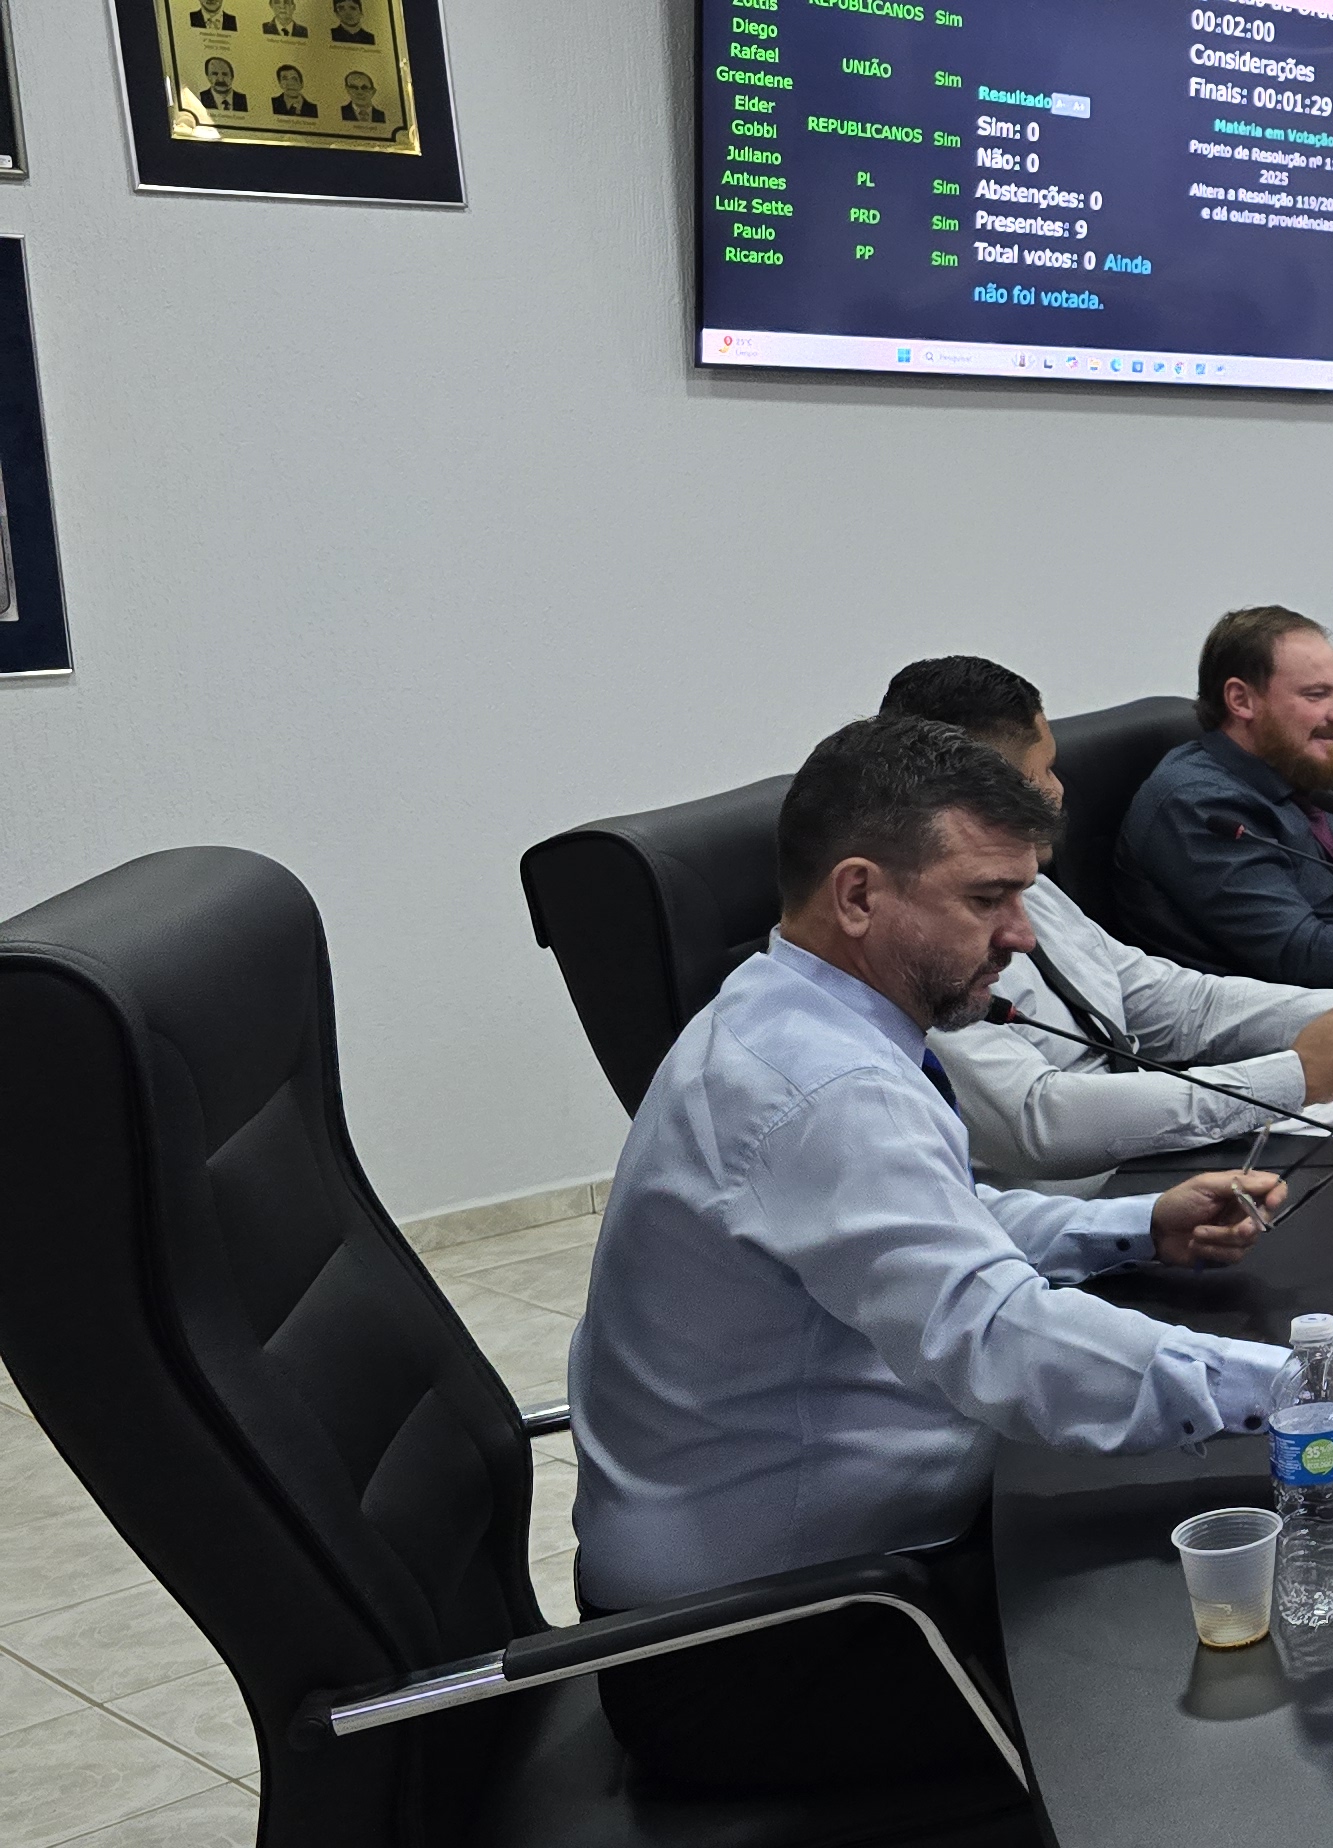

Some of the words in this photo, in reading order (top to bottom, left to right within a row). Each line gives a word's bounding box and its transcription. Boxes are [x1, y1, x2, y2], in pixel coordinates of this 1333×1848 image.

[809, 0, 924, 21] UBLICANOS
[935, 10, 963, 27] Sim
[732, 17, 778, 40] Diego
[1191, 8, 1275, 42] 00:02:00
[730, 42, 779, 63] Rafael
[1190, 43, 1315, 82] Considerações
[716, 66, 794, 90] Grendene
[842, 58, 892, 78] UNIÃO
[934, 71, 962, 88] Sim
[734, 94, 776, 114] Elder
[978, 86, 1052, 109] Resultado
[1189, 76, 1248, 105] Finais:
[1253, 86, 1333, 117] 00:01:29
[731, 119, 777, 139] Gobbi
[808, 116, 923, 143] REPUBLICANOS
[977, 115, 1021, 140] Sim:
[1026, 121, 1040, 142] 0
[1214, 118, 1262, 138] Matéria
[1265, 126, 1285, 141] em
[933, 131, 961, 148] Sim
[726, 145, 782, 165] Juliano
[977, 147, 1021, 171] Não:
[1026, 153, 1040, 173] 0
[1189, 139, 1232, 158] Projeto
[1234, 145, 1250, 160] de
[1251, 148, 1307, 168] Resolução
[721, 170, 787, 190] Antunes
[857, 171, 875, 188] PL
[932, 179, 960, 196] Sim
[1259, 169, 1289, 186] 2025
[975, 179, 1085, 209] Abstenções:
[1089, 191, 1103, 211] 0
[1189, 183, 1225, 199] Altera
[1227, 188, 1236, 201] a
[1238, 188, 1293, 208] Resolução
[715, 195, 748, 213] Luiz
[751, 198, 794, 217] Sette
[849, 207, 881, 225] PRD
[1201, 208, 1210, 219] e
[1212, 206, 1227, 221] dá
[1230, 209, 1266, 225] outras
[733, 222, 776, 241] Paulo
[931, 215, 959, 232] Sim
[975, 209, 1070, 238] Presentes:
[1075, 219, 1088, 239] 9
[725, 246, 784, 265] Ricardo
[855, 245, 874, 260] PP
[931, 251, 959, 267] Sim
[973, 241, 1019, 264] Total
[1024, 248, 1078, 269] votos:
[1083, 250, 1097, 271] 0
[1103, 253, 1152, 275] Ainda
[973, 282, 1007, 304] não
[1012, 285, 1035, 305] foi
[1041, 290, 1104, 310] votada.
